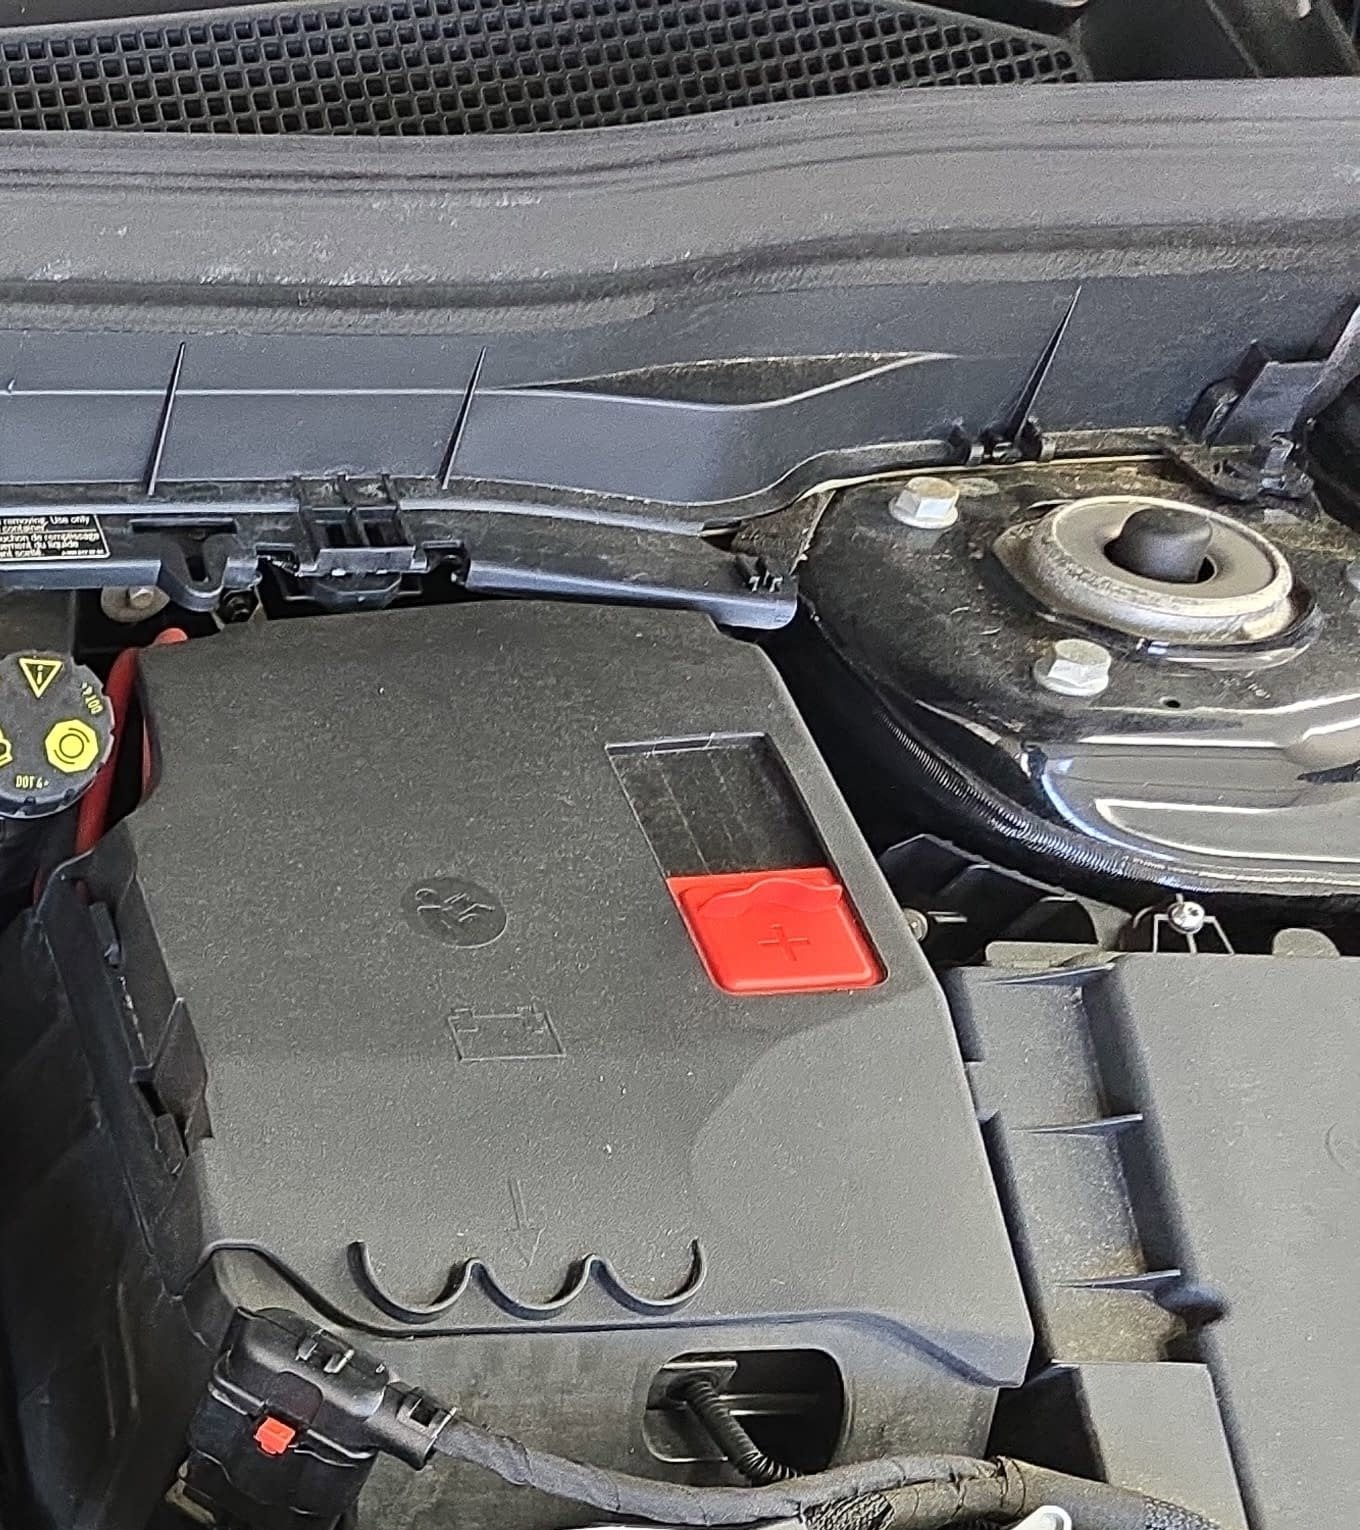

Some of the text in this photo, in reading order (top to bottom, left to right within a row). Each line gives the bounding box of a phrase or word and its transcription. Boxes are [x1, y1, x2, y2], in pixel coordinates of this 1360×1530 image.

[49, 516, 69, 524] Use
[71, 515, 89, 526] only
[31, 533, 42, 542] de
[85, 695, 104, 715] DOT
[15, 775, 34, 789] DOT
